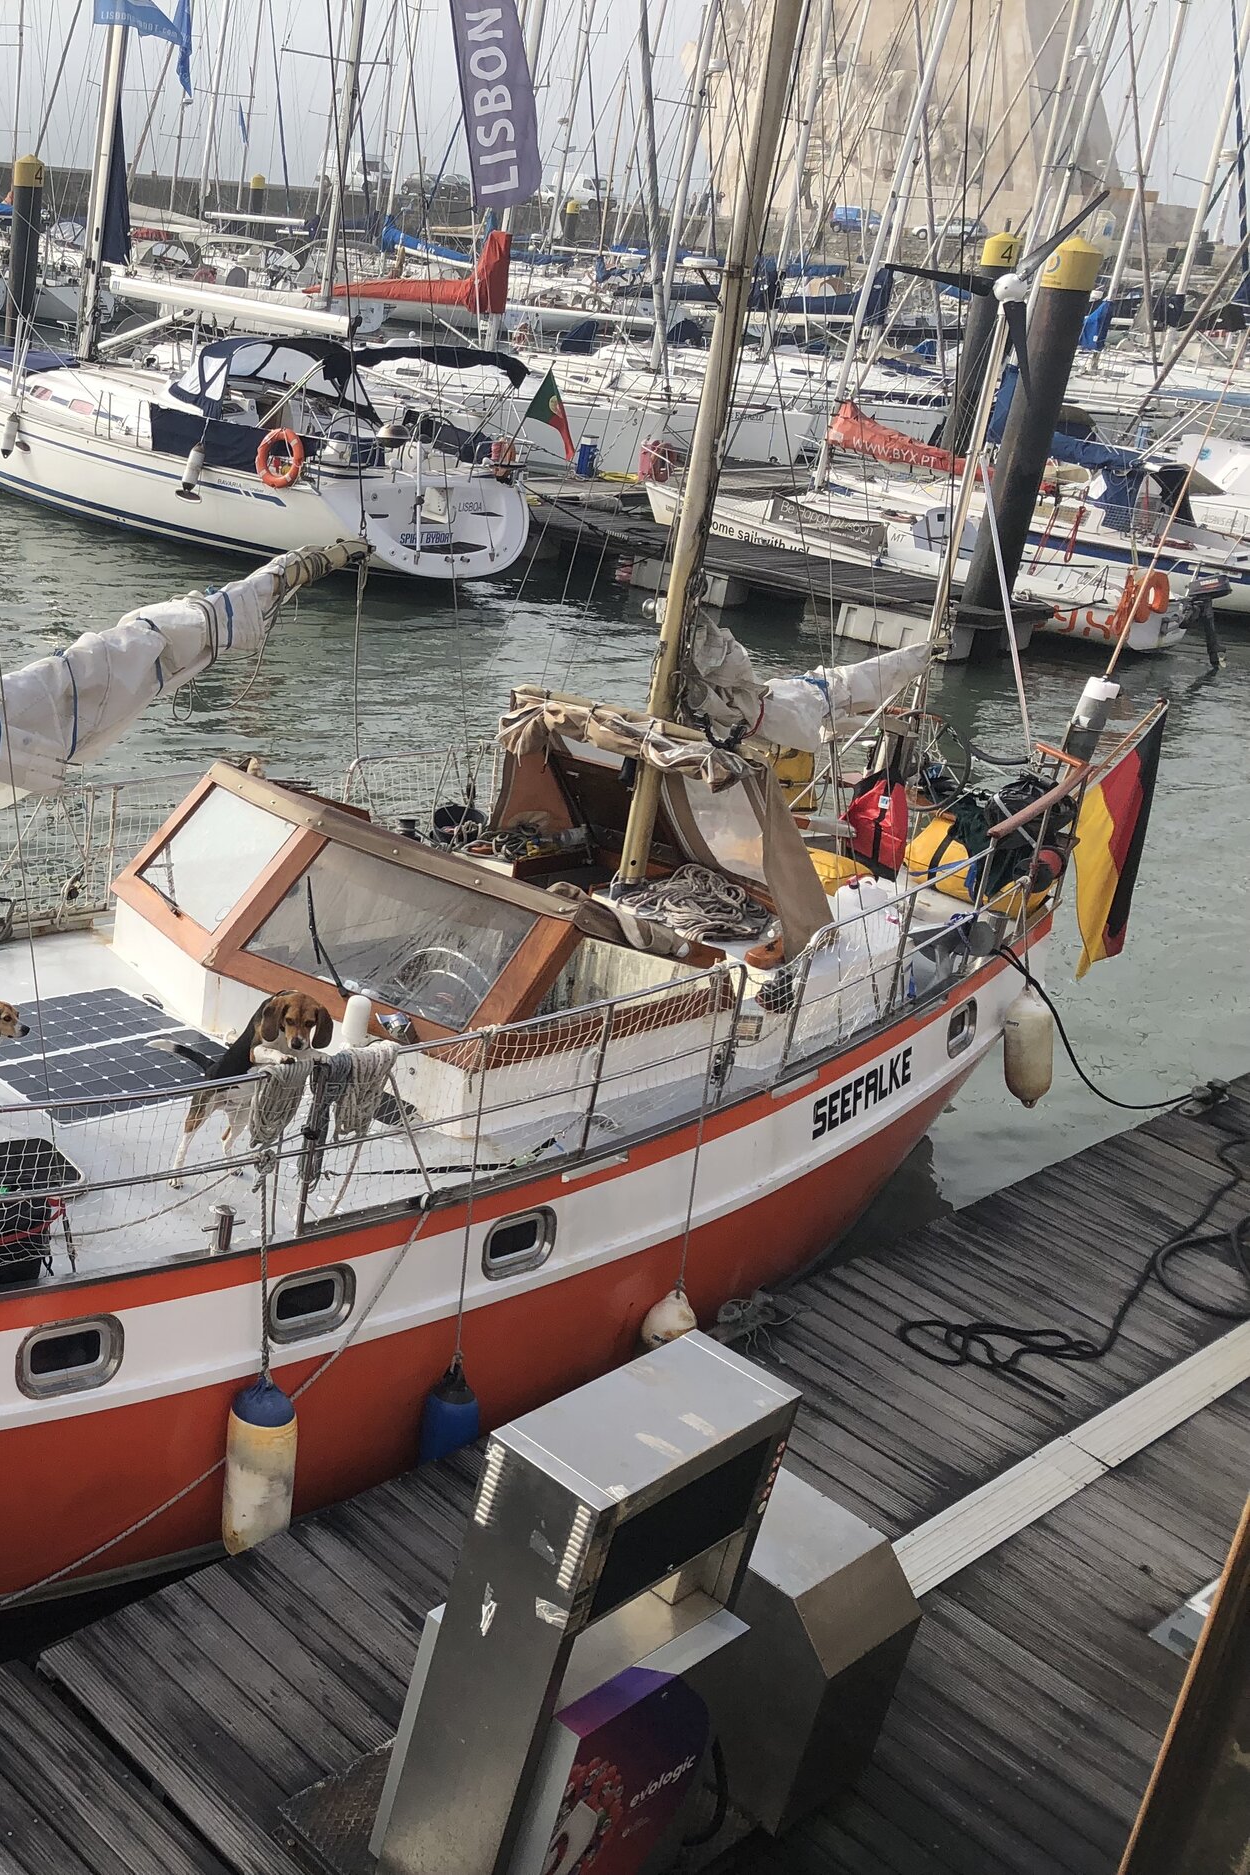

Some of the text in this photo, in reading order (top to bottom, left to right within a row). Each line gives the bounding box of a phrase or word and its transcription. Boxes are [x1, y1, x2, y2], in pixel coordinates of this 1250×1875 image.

[465, 8, 519, 195] LISBON
[35, 165, 43, 185] 4
[1000, 243, 1013, 263] 4
[852, 436, 937, 468] WWW.BYX.PT
[217, 478, 242, 489] BAVARIA
[458, 501, 483, 512] LISBOA
[780, 499, 795, 515] Be
[796, 505, 829, 526] Happy
[399, 533, 425, 544] SPIRT
[710, 520, 735, 537] ome
[812, 1046, 912, 1140] SEEFALKE
[630, 1754, 696, 1808] evologic
